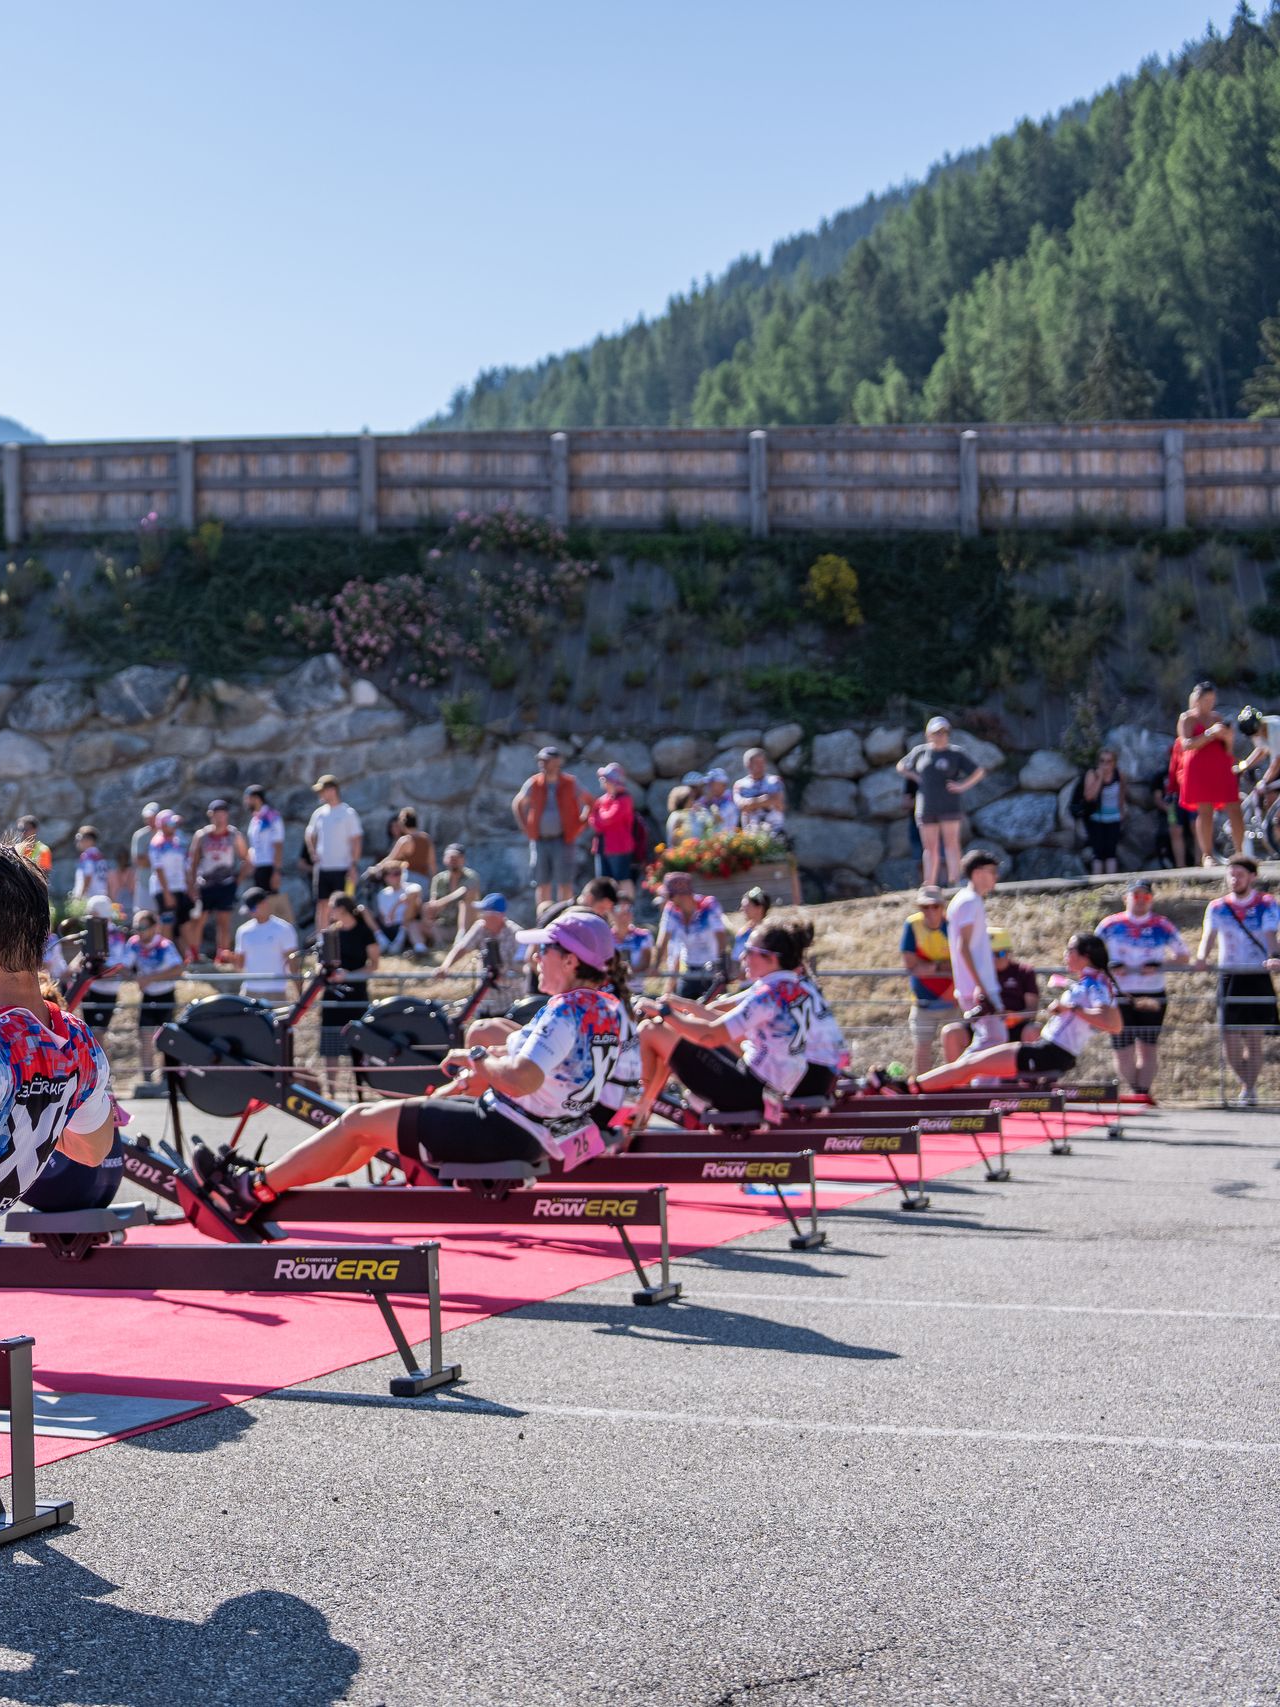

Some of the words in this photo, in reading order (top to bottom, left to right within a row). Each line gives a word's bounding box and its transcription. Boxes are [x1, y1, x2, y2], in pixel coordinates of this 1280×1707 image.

[574, 1134, 589, 1158] 26
[701, 1162, 791, 1179] RowERG
[533, 1199, 638, 1217] RowERG
[274, 1259, 400, 1281] RowERG
